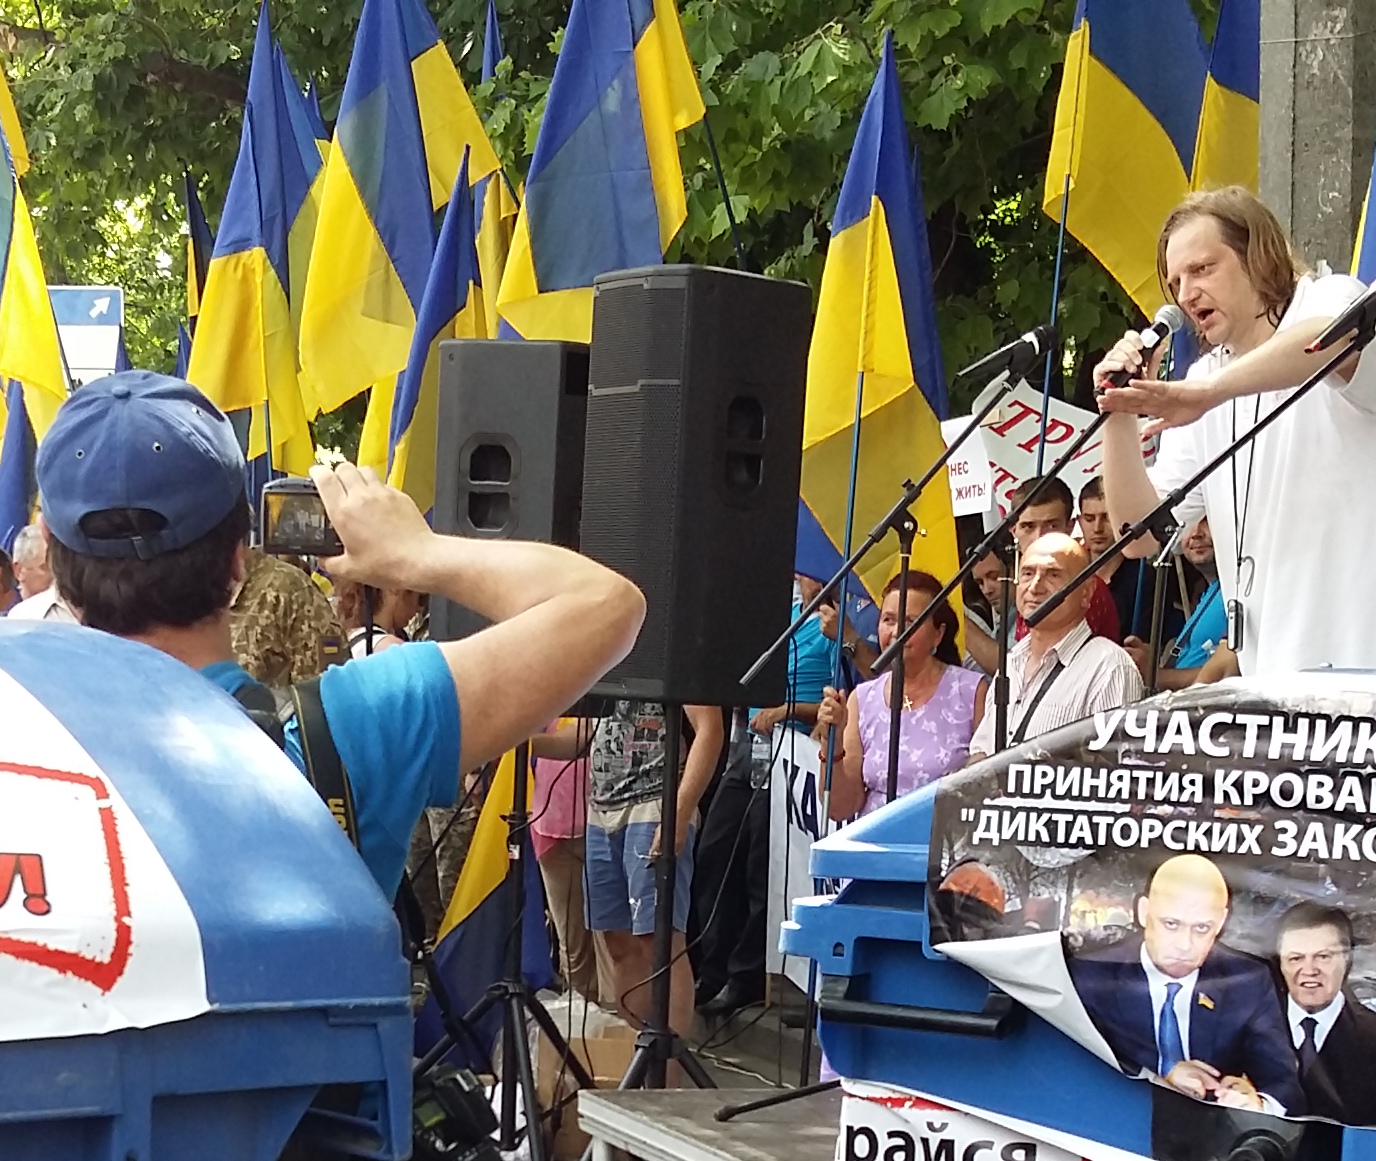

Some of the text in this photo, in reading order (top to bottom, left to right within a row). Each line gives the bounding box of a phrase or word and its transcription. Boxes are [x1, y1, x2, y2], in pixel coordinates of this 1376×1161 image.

[948, 461, 969, 478] НЕС
[955, 483, 986, 501] ЖИТЬ!
[1007, 761, 1204, 806] ПРИНЯТИЯ
[960, 809, 1263, 858] "ДИКТАТОРСКИХ
